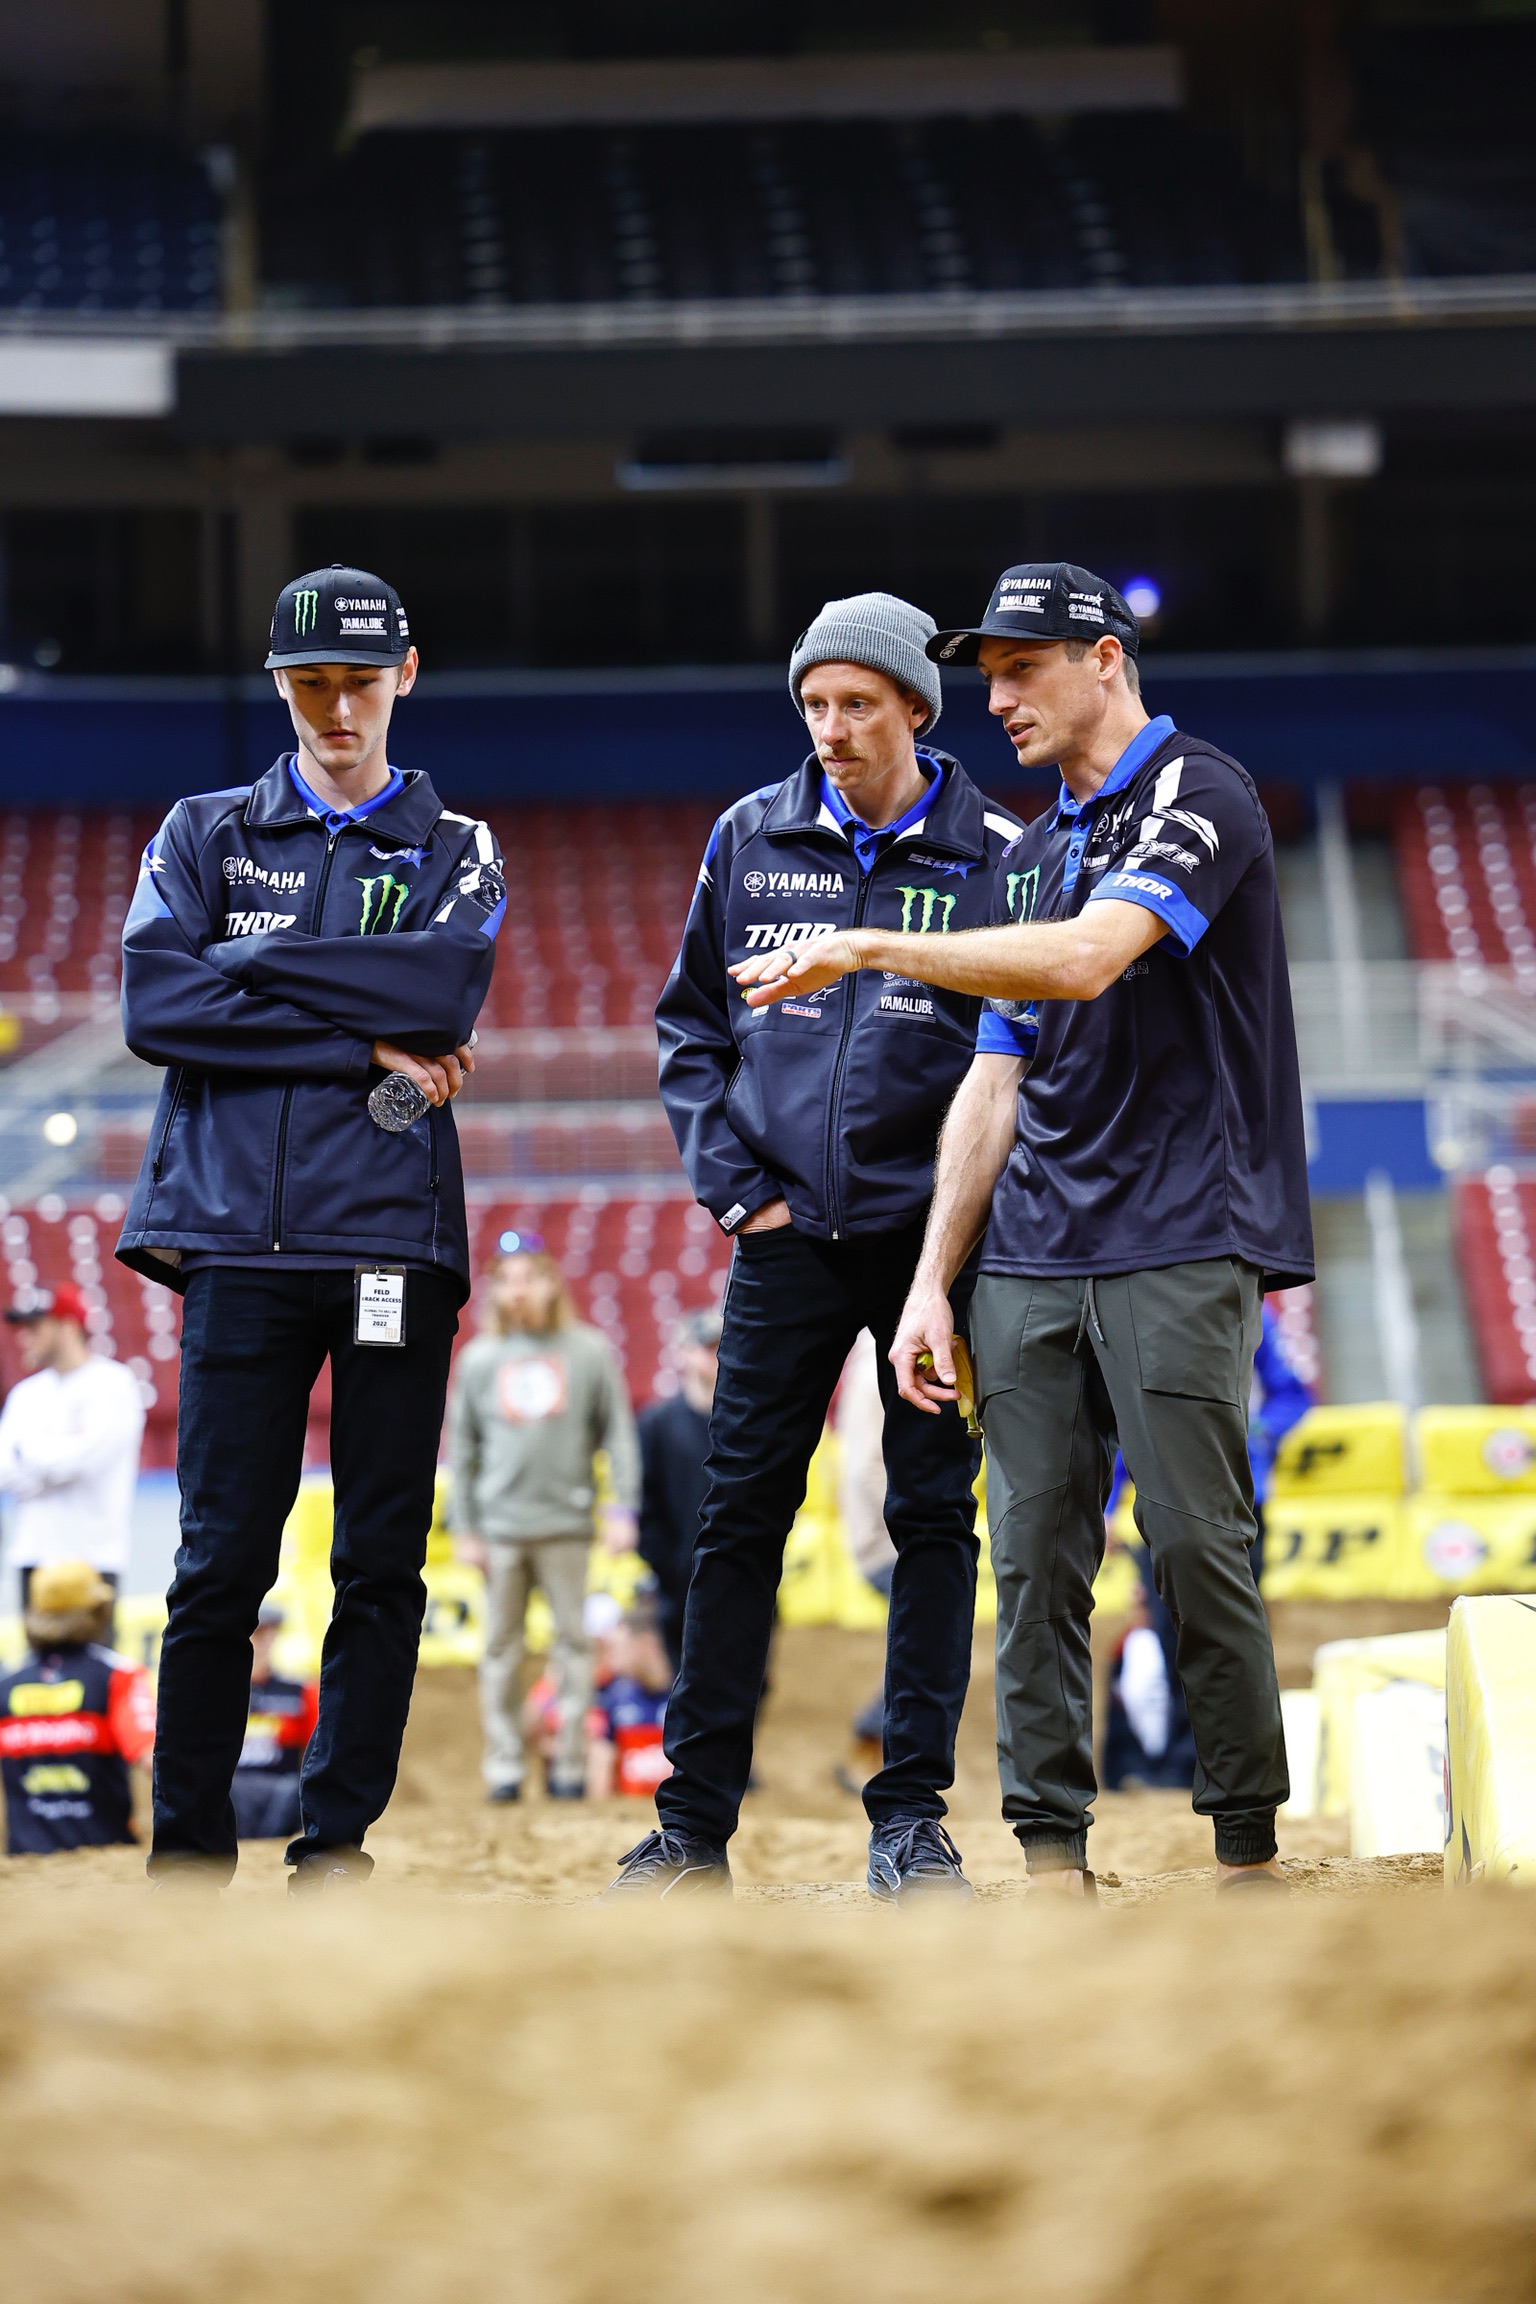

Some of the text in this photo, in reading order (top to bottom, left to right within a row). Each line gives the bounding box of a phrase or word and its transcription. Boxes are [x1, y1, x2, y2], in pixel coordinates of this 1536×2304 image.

[1010, 578, 1051, 590] YAMAHA
[348, 599, 387, 611] YAMAHA
[999, 595, 1042, 607] YAMALUBE
[340, 617, 384, 629] YAMALUBE
[236, 857, 306, 889] YAMAHA
[767, 872, 844, 893] YAMAHA
[1112, 873, 1173, 901] THOR
[880, 995, 933, 1015] YAMALUBE
